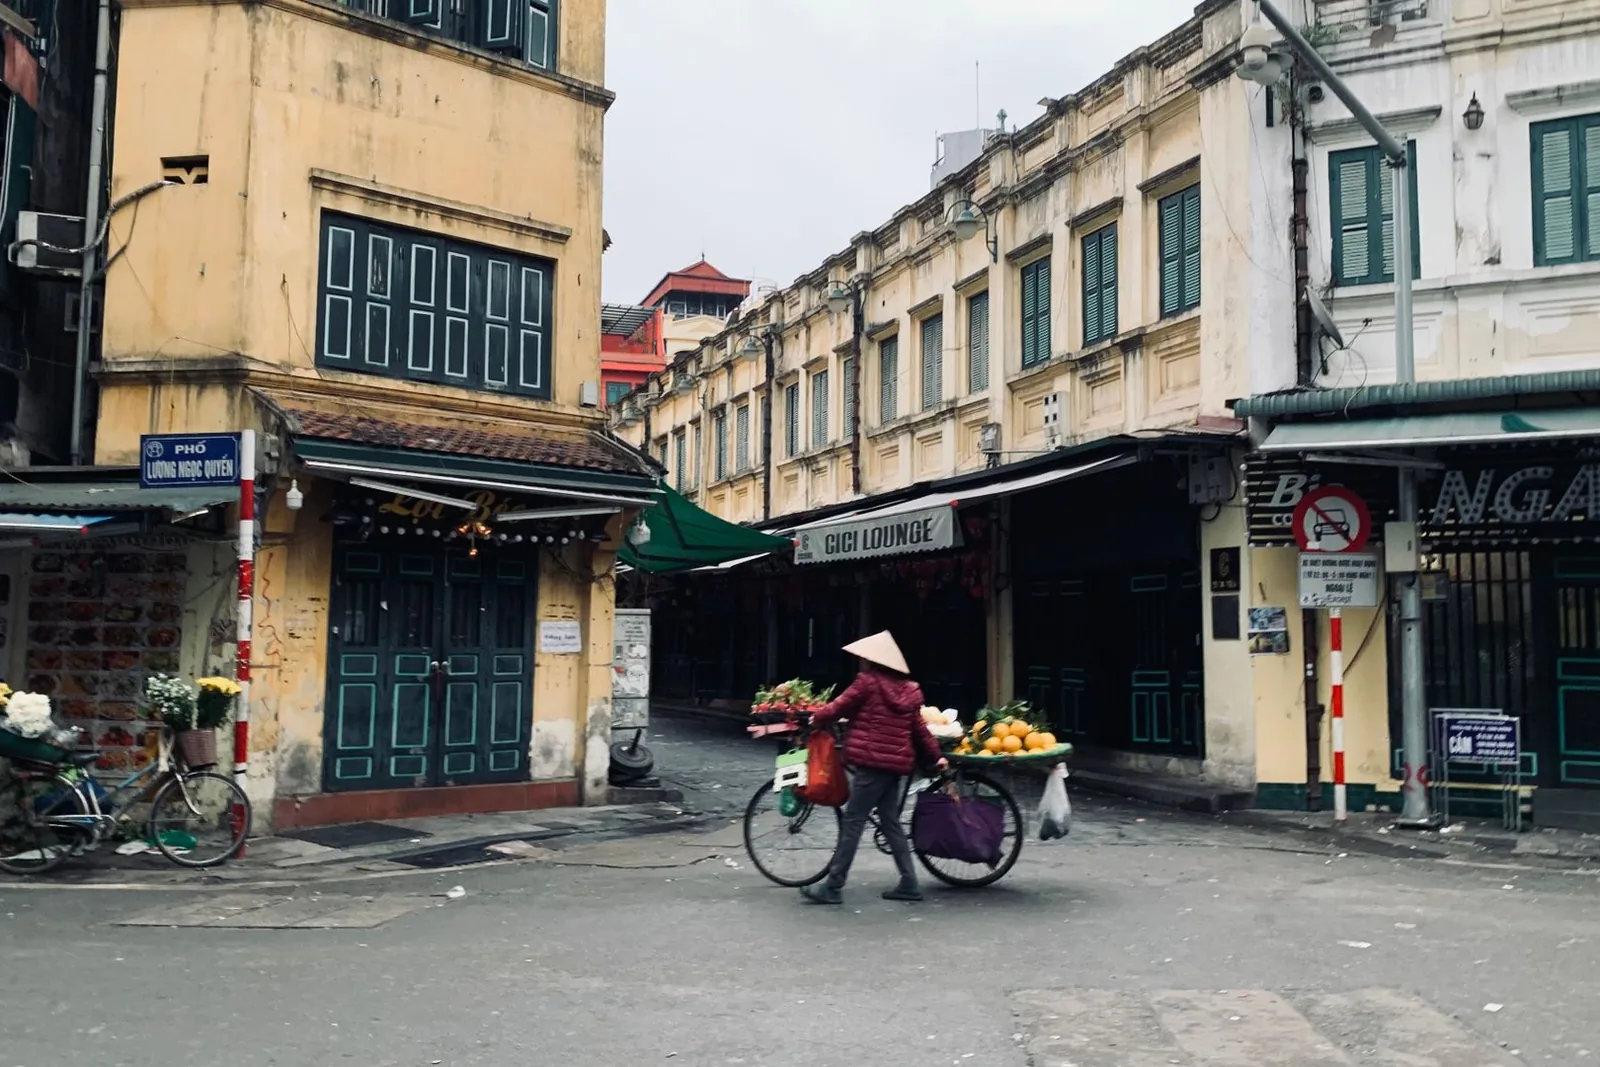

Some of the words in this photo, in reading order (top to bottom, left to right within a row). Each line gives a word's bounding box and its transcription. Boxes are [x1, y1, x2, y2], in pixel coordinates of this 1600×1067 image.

[174, 440, 206, 454] PHỐ
[147, 460, 177, 479] LƯƠNG
[178, 459, 202, 481] NGỌC
[204, 454, 233, 479] QUYẾN
[824, 531, 858, 555] CICI
[862, 518, 933, 550] LOUNGE
